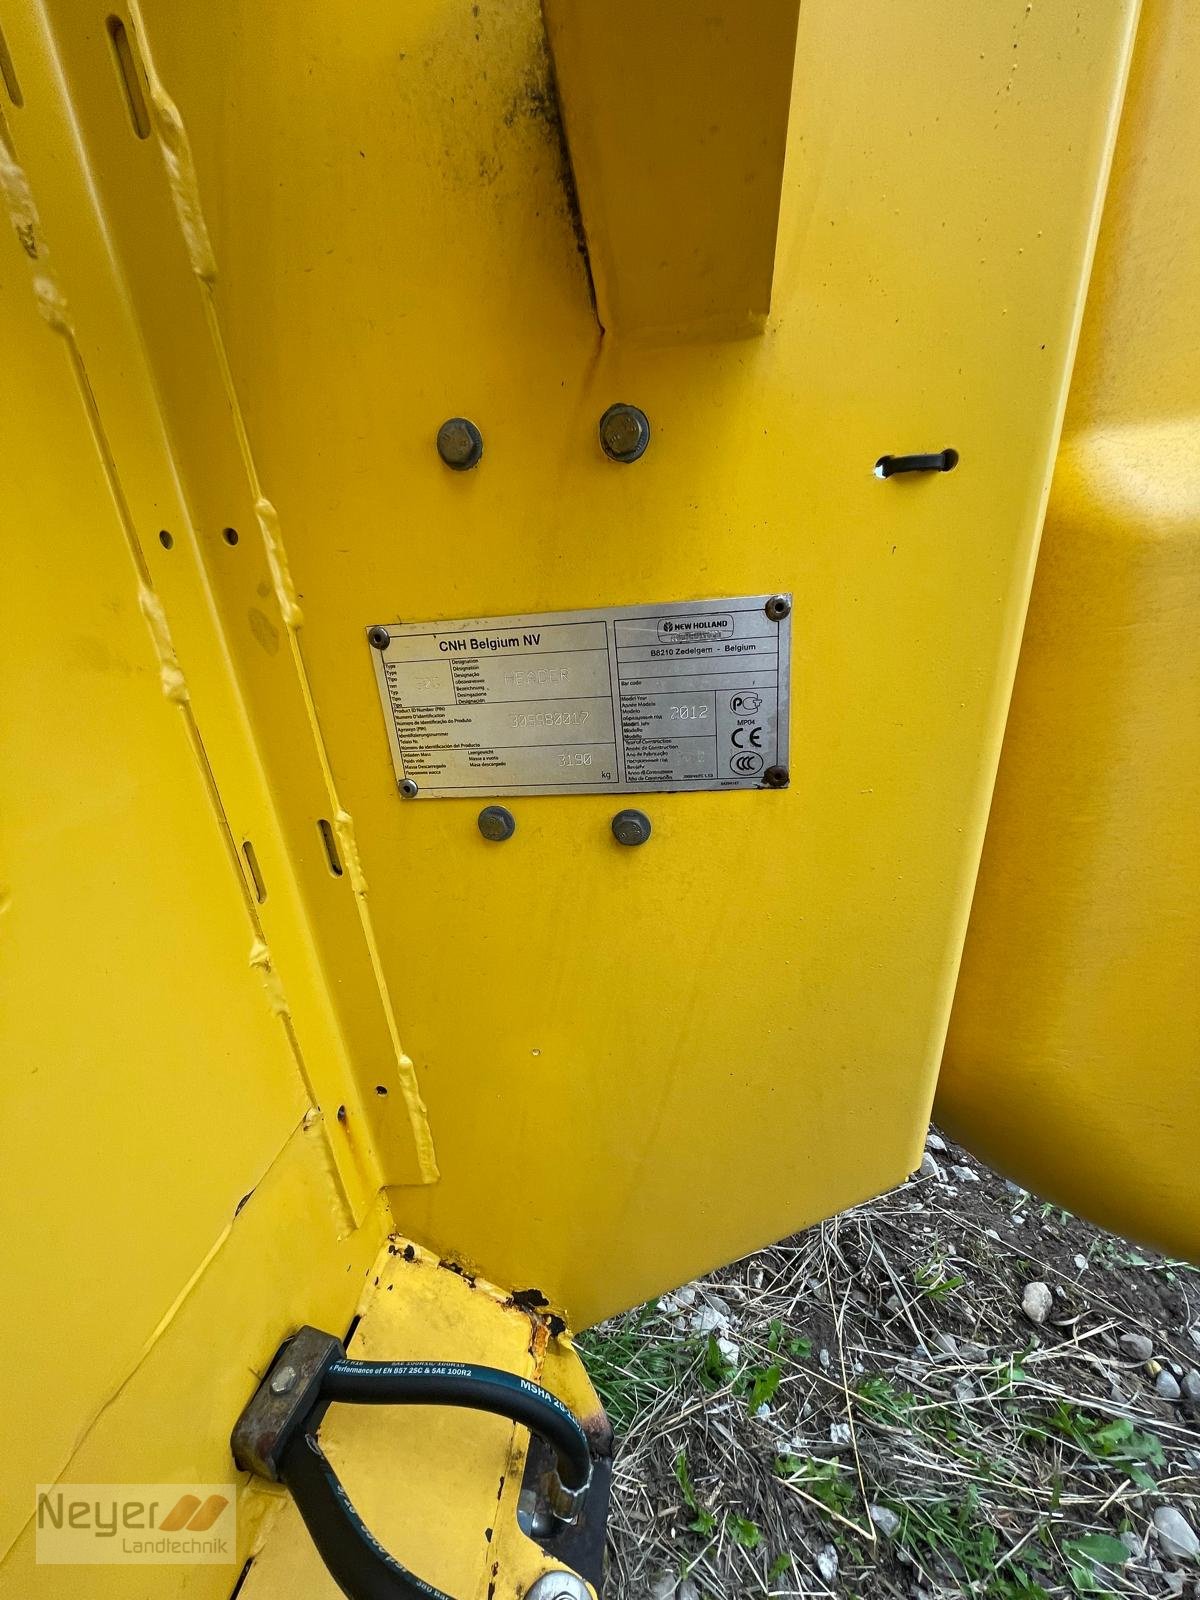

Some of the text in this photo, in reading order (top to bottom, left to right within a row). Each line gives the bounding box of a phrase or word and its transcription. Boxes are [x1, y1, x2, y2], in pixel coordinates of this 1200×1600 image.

[674, 620, 728, 630] NEW HOLLAND
[440, 634, 541, 652] CNH Belgium NV
[650, 648, 674, 656] B8210
[676, 646, 712, 656] Zedelgem
[724, 644, 756, 653] Belgium
[504, 668, 570, 686] HEADER
[670, 705, 708, 720] 2012
[731, 726, 762, 748] CE
[558, 754, 592, 766] 3190
[601, 770, 611, 780] kg
[333, 1364, 374, 1374] Performance
[447, 1368, 472, 1376] 100R2
[520, 1379, 552, 1403] MSHA
